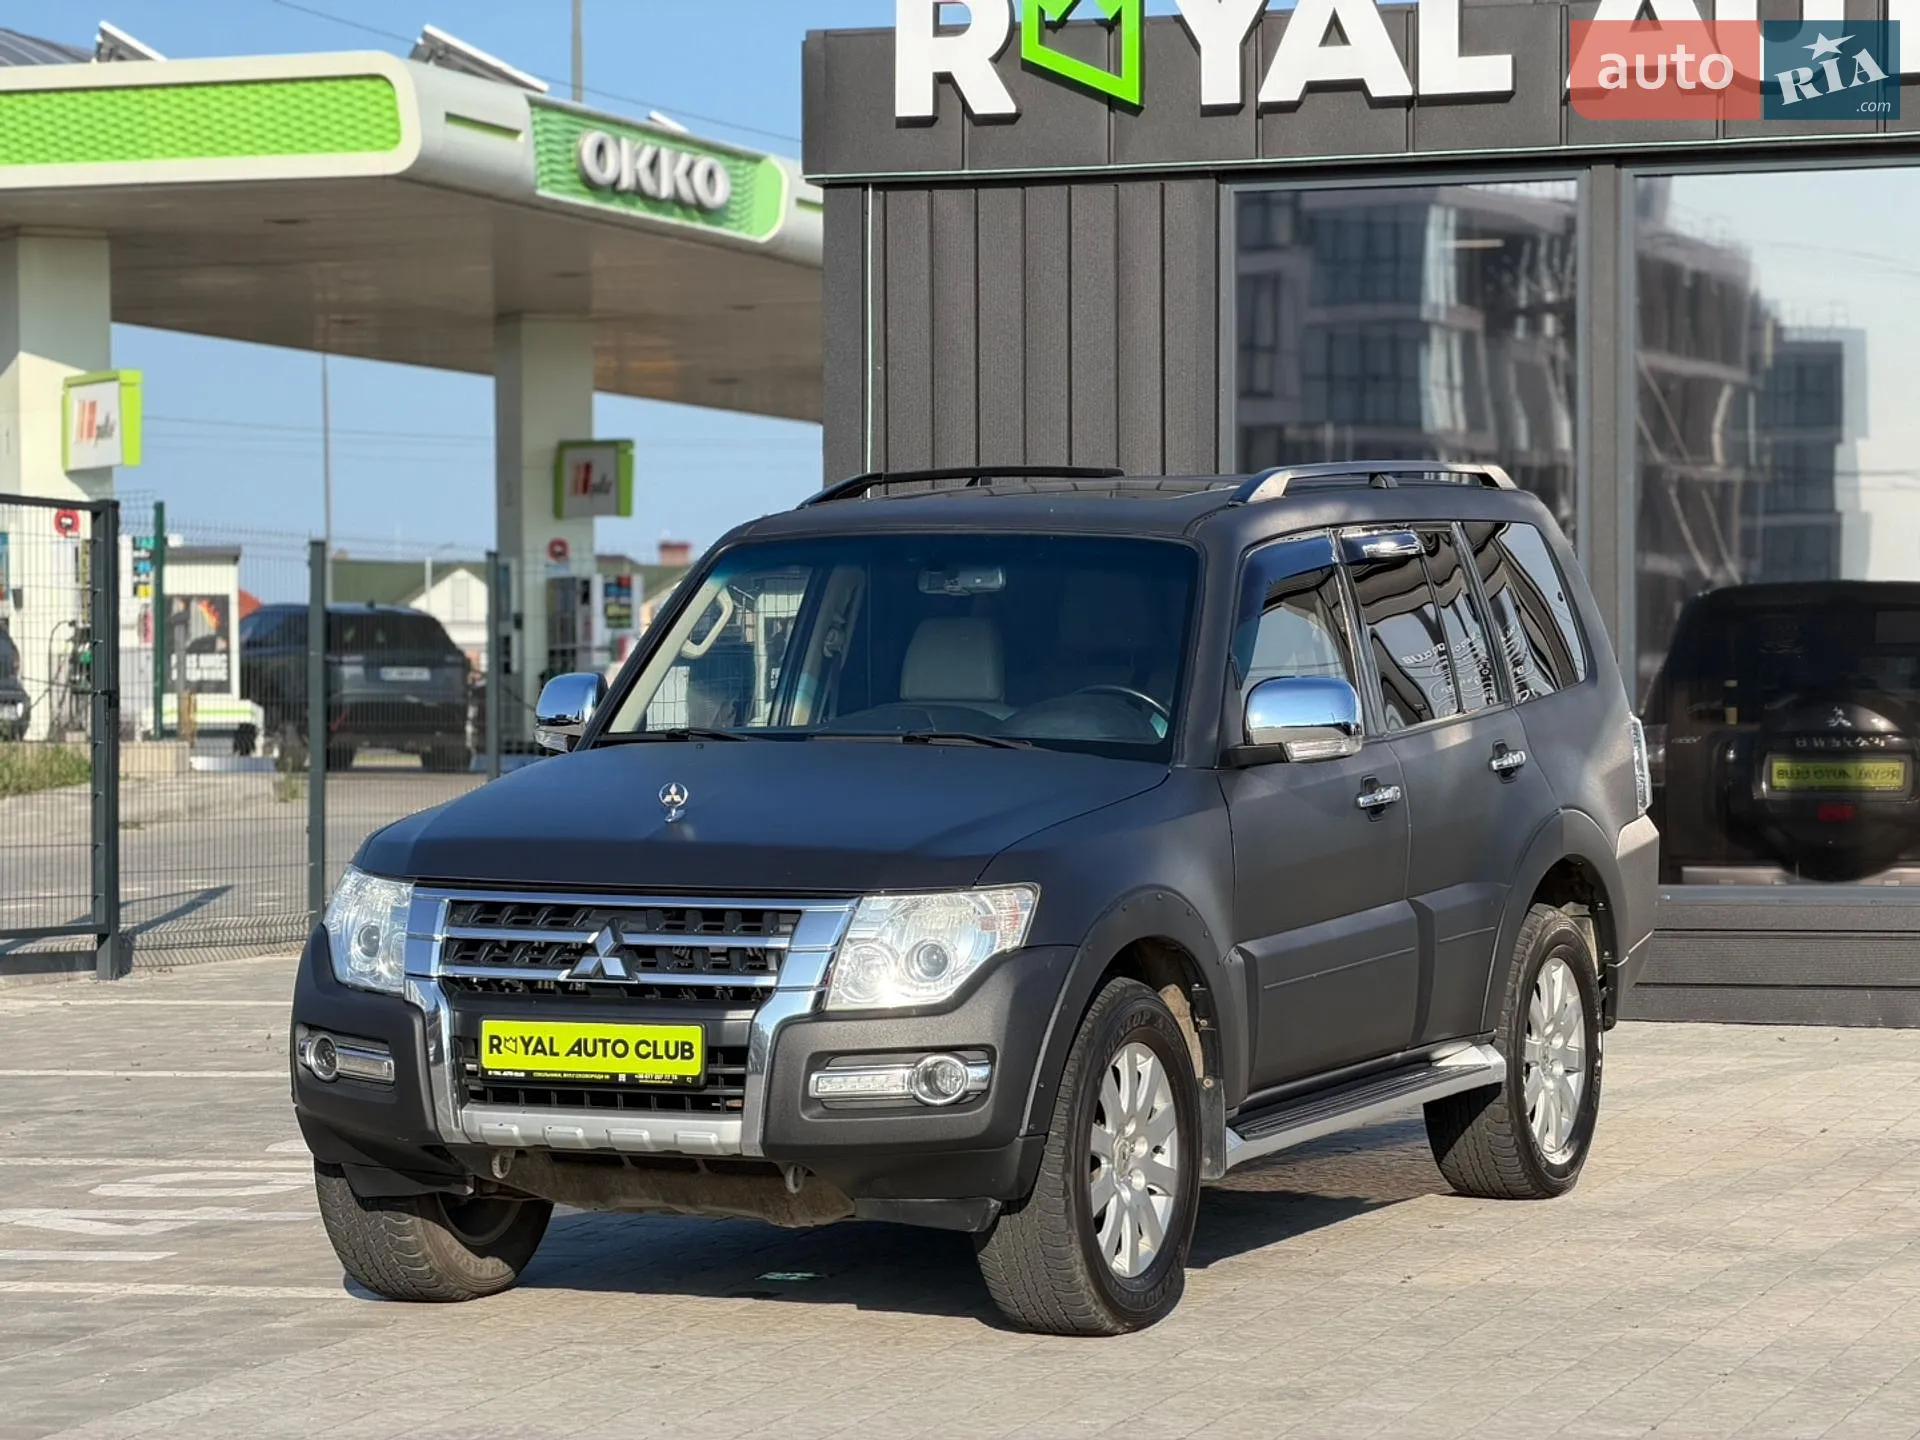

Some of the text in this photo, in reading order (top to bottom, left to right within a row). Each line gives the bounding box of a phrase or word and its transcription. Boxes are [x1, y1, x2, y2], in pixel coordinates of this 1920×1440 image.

[580, 130, 731, 210] OKKO
[565, 1038, 630, 1059] AUTO
[634, 1039, 695, 1061] CLUB
